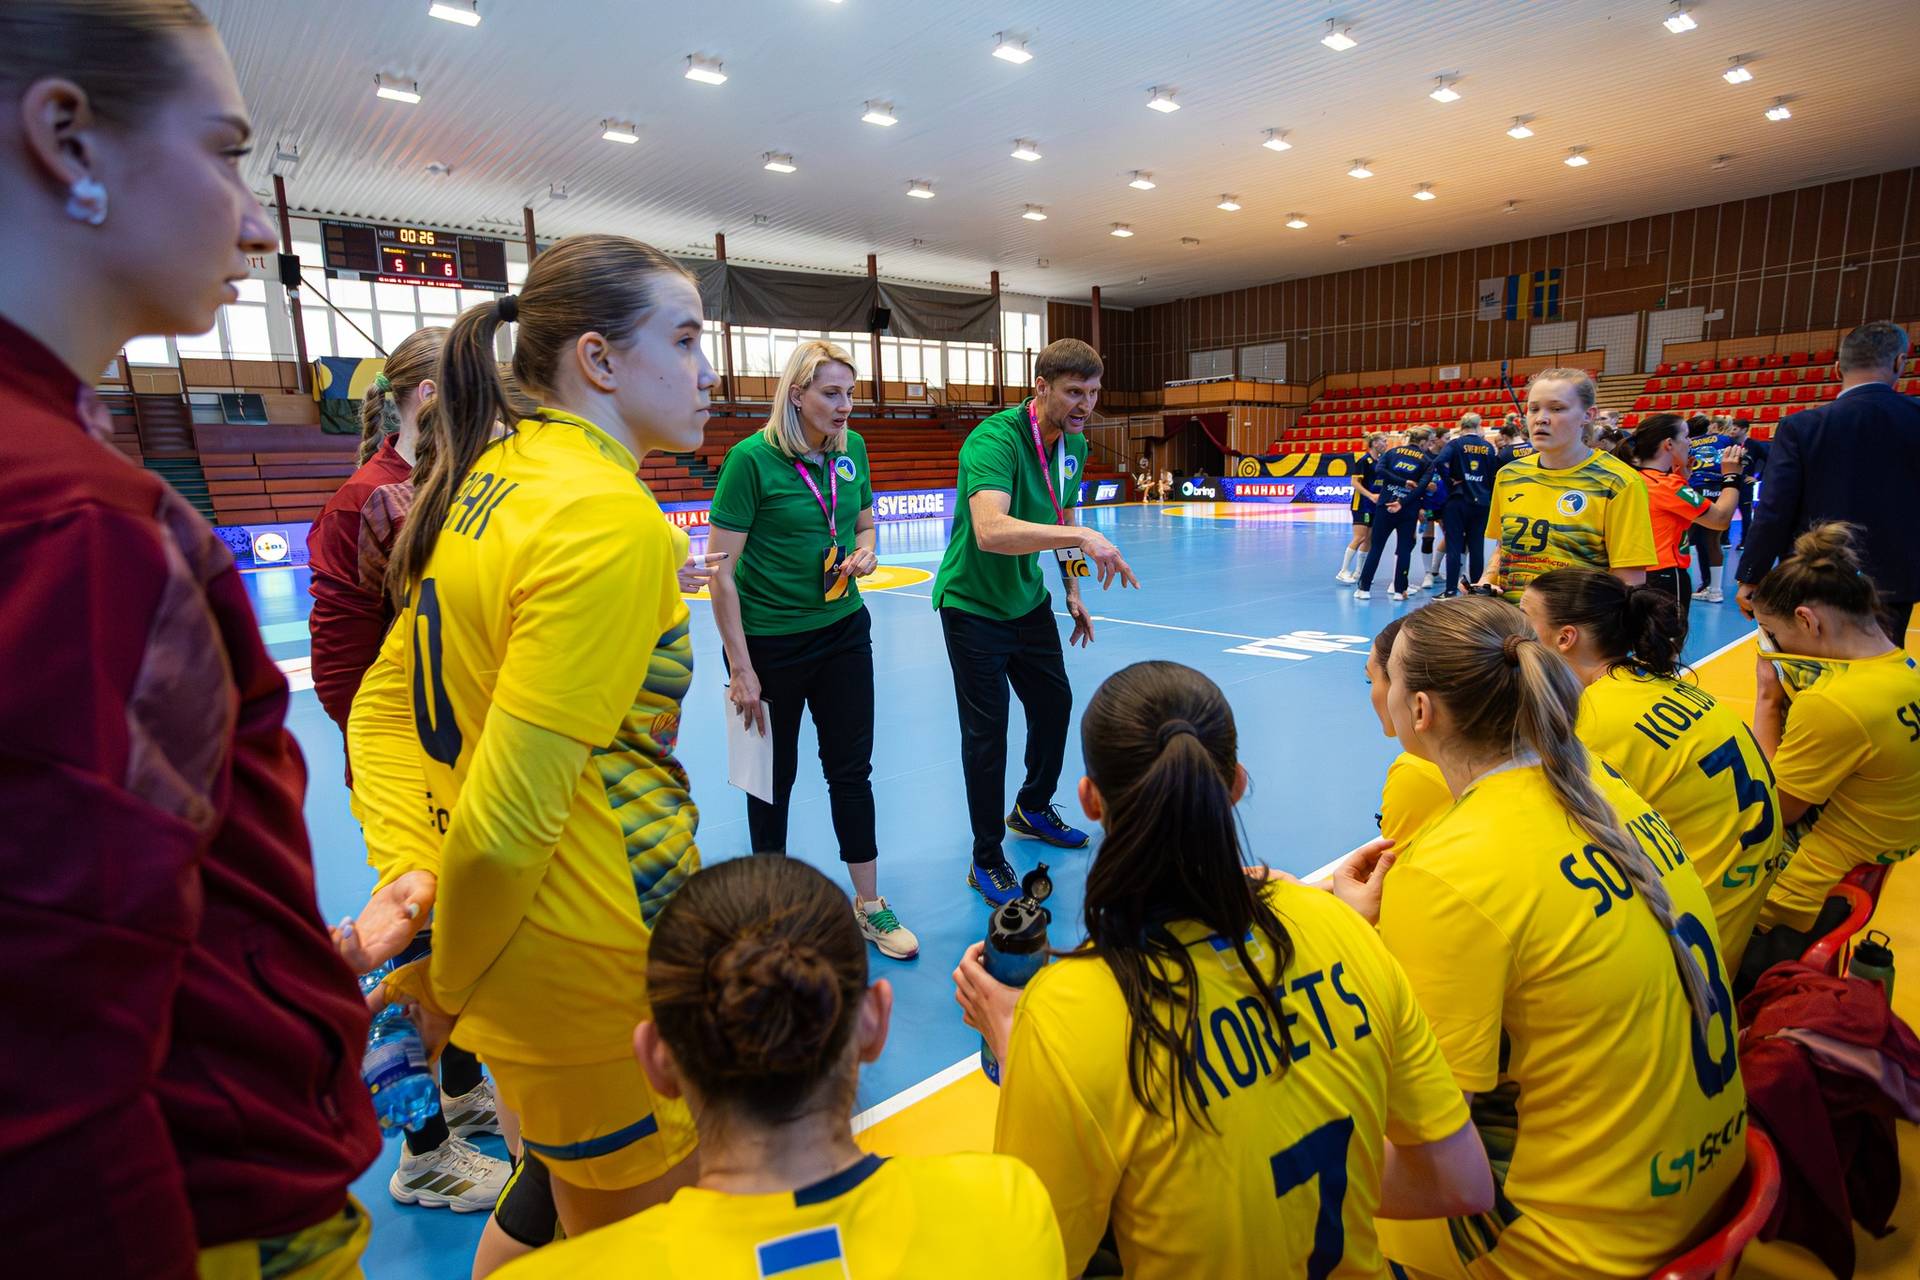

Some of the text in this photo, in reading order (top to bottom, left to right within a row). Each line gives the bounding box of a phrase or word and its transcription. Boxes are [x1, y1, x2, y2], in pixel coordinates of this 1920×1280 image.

[400, 228, 435, 245] 00:26
[394, 259, 404, 272] 5
[421, 262, 425, 273] 1
[444, 263, 453, 276] 6
[1396, 447, 1424, 459] SVERIGE
[1463, 445, 1489, 455] SVERIGE
[1193, 486, 1216, 498] bring
[1235, 484, 1295, 497] BAUHAUS
[878, 493, 944, 516] SVERIGE
[1510, 517, 1550, 552] 29
[1270, 1113, 1355, 1280] 7
